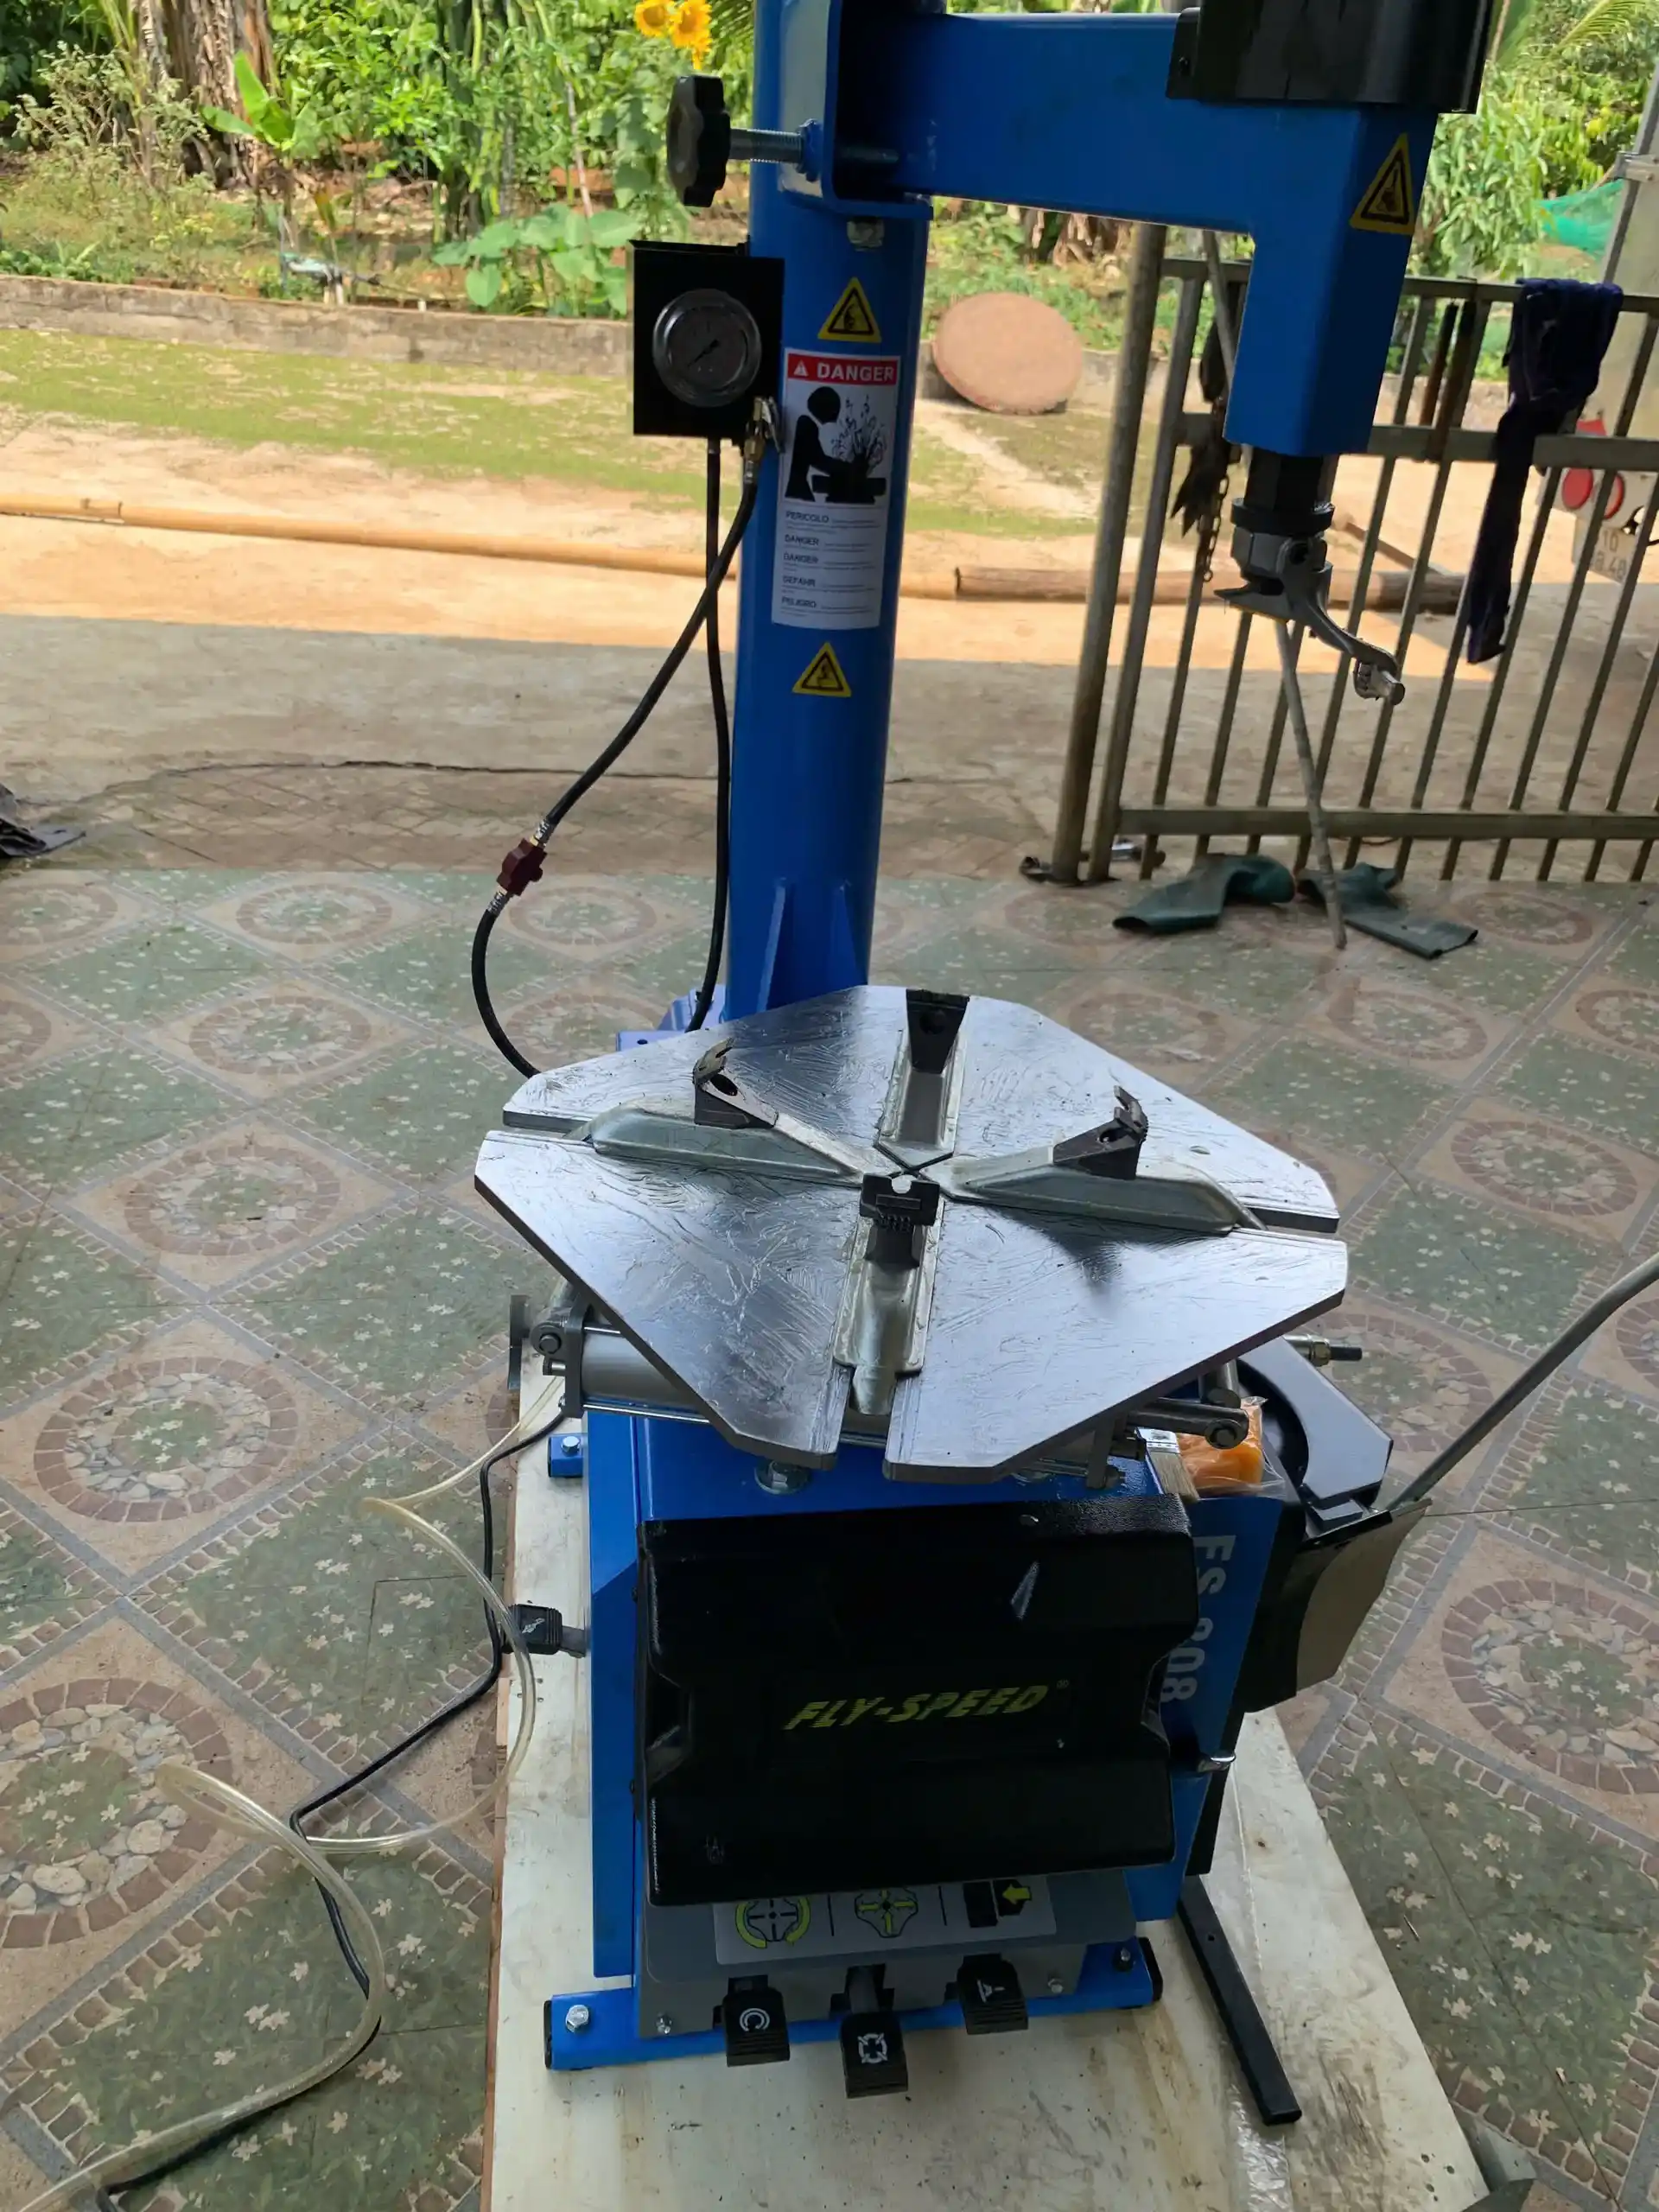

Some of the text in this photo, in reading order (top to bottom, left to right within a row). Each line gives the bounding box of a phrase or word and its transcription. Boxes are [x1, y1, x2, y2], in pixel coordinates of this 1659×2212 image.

[817, 361, 894, 382] DANGER
[785, 511, 830, 524] PERICOLO
[784, 534, 820, 546] DANGER
[783, 552, 819, 563] DANGER
[782, 575, 816, 587] GEFAHR
[784, 1685, 1048, 1730] FLY-SPEED
